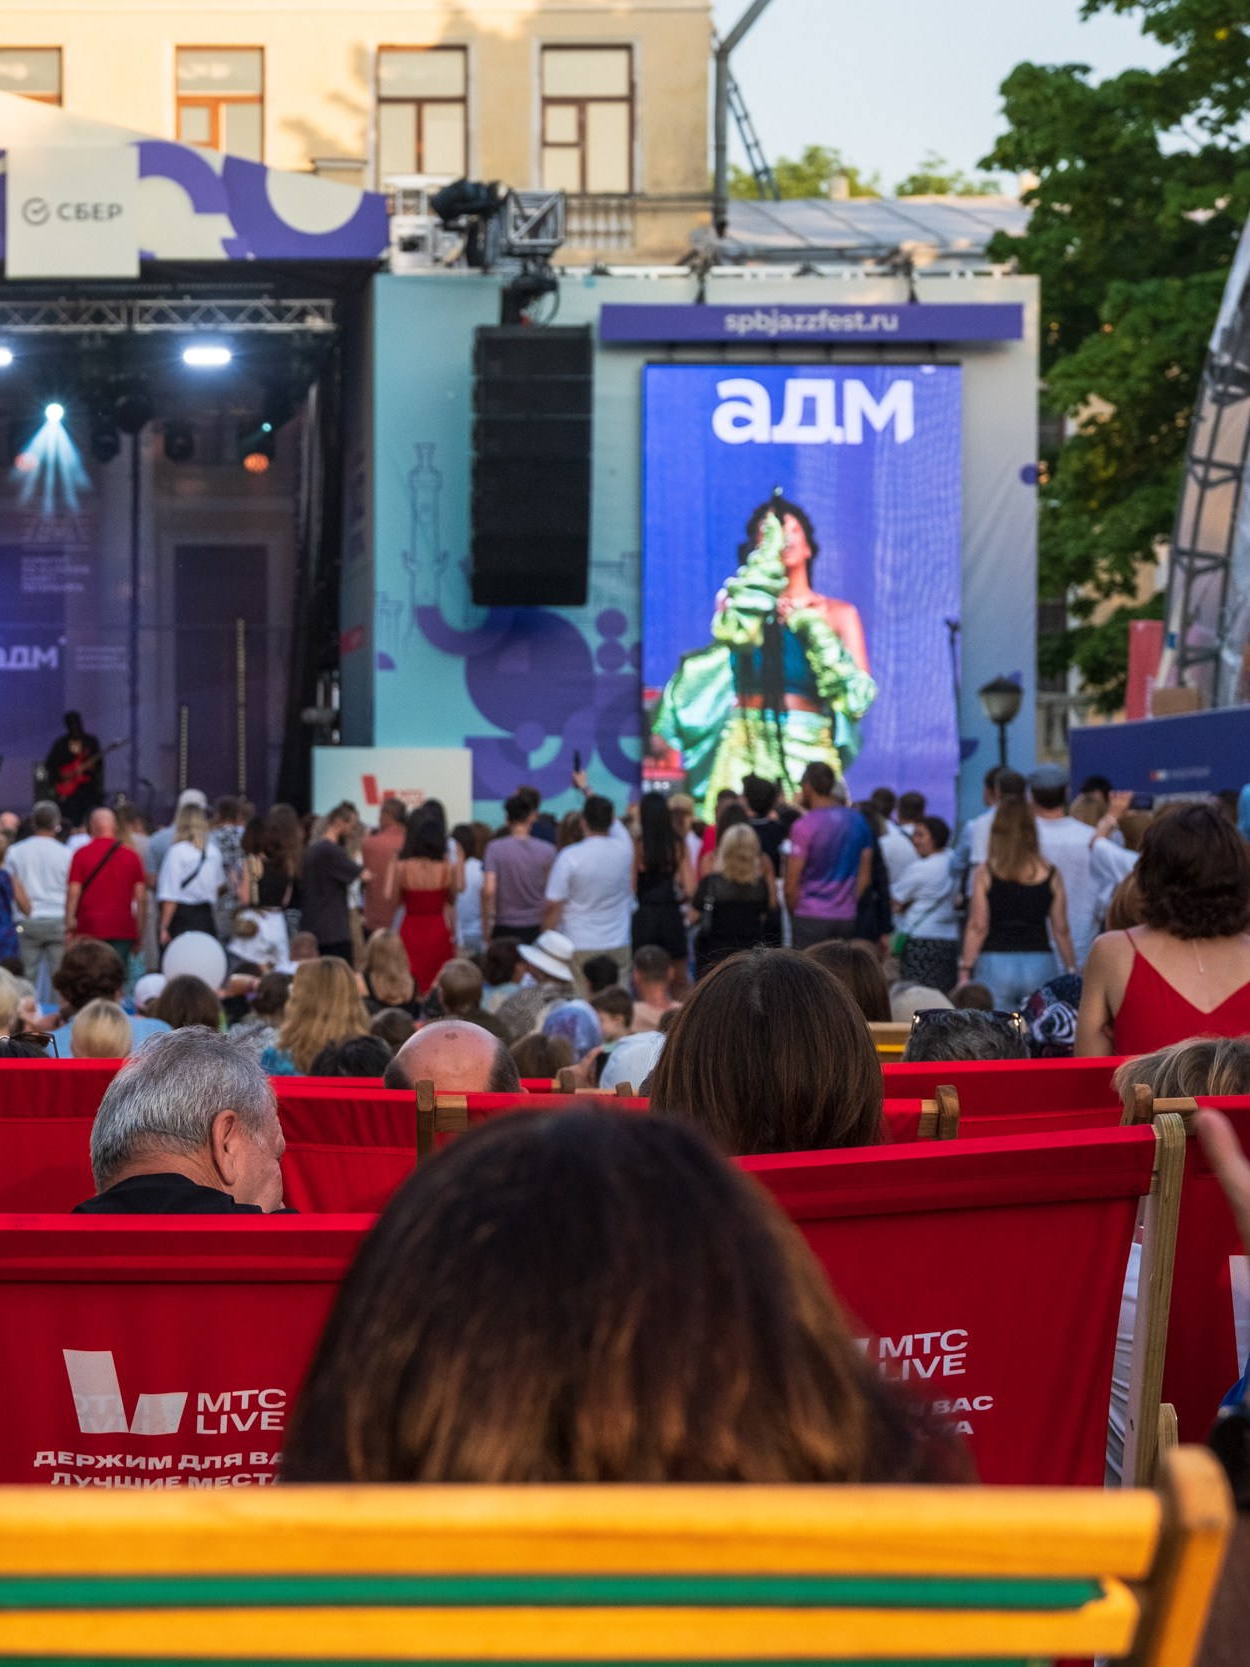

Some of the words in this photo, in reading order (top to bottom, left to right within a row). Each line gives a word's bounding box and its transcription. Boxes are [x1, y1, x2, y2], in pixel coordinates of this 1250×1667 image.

[56, 202, 123, 221] СБЕР
[724, 309, 899, 336] spbjazzfest.ru
[712, 378, 914, 445] адм
[878, 1353, 967, 1382] LIVE
[196, 1411, 285, 1435] LIVE
[33, 1451, 172, 1470] ДЕРЖИМ
[178, 1452, 243, 1471] ДЛЯ
[50, 1472, 182, 1490] ЛУЧШИЕ
